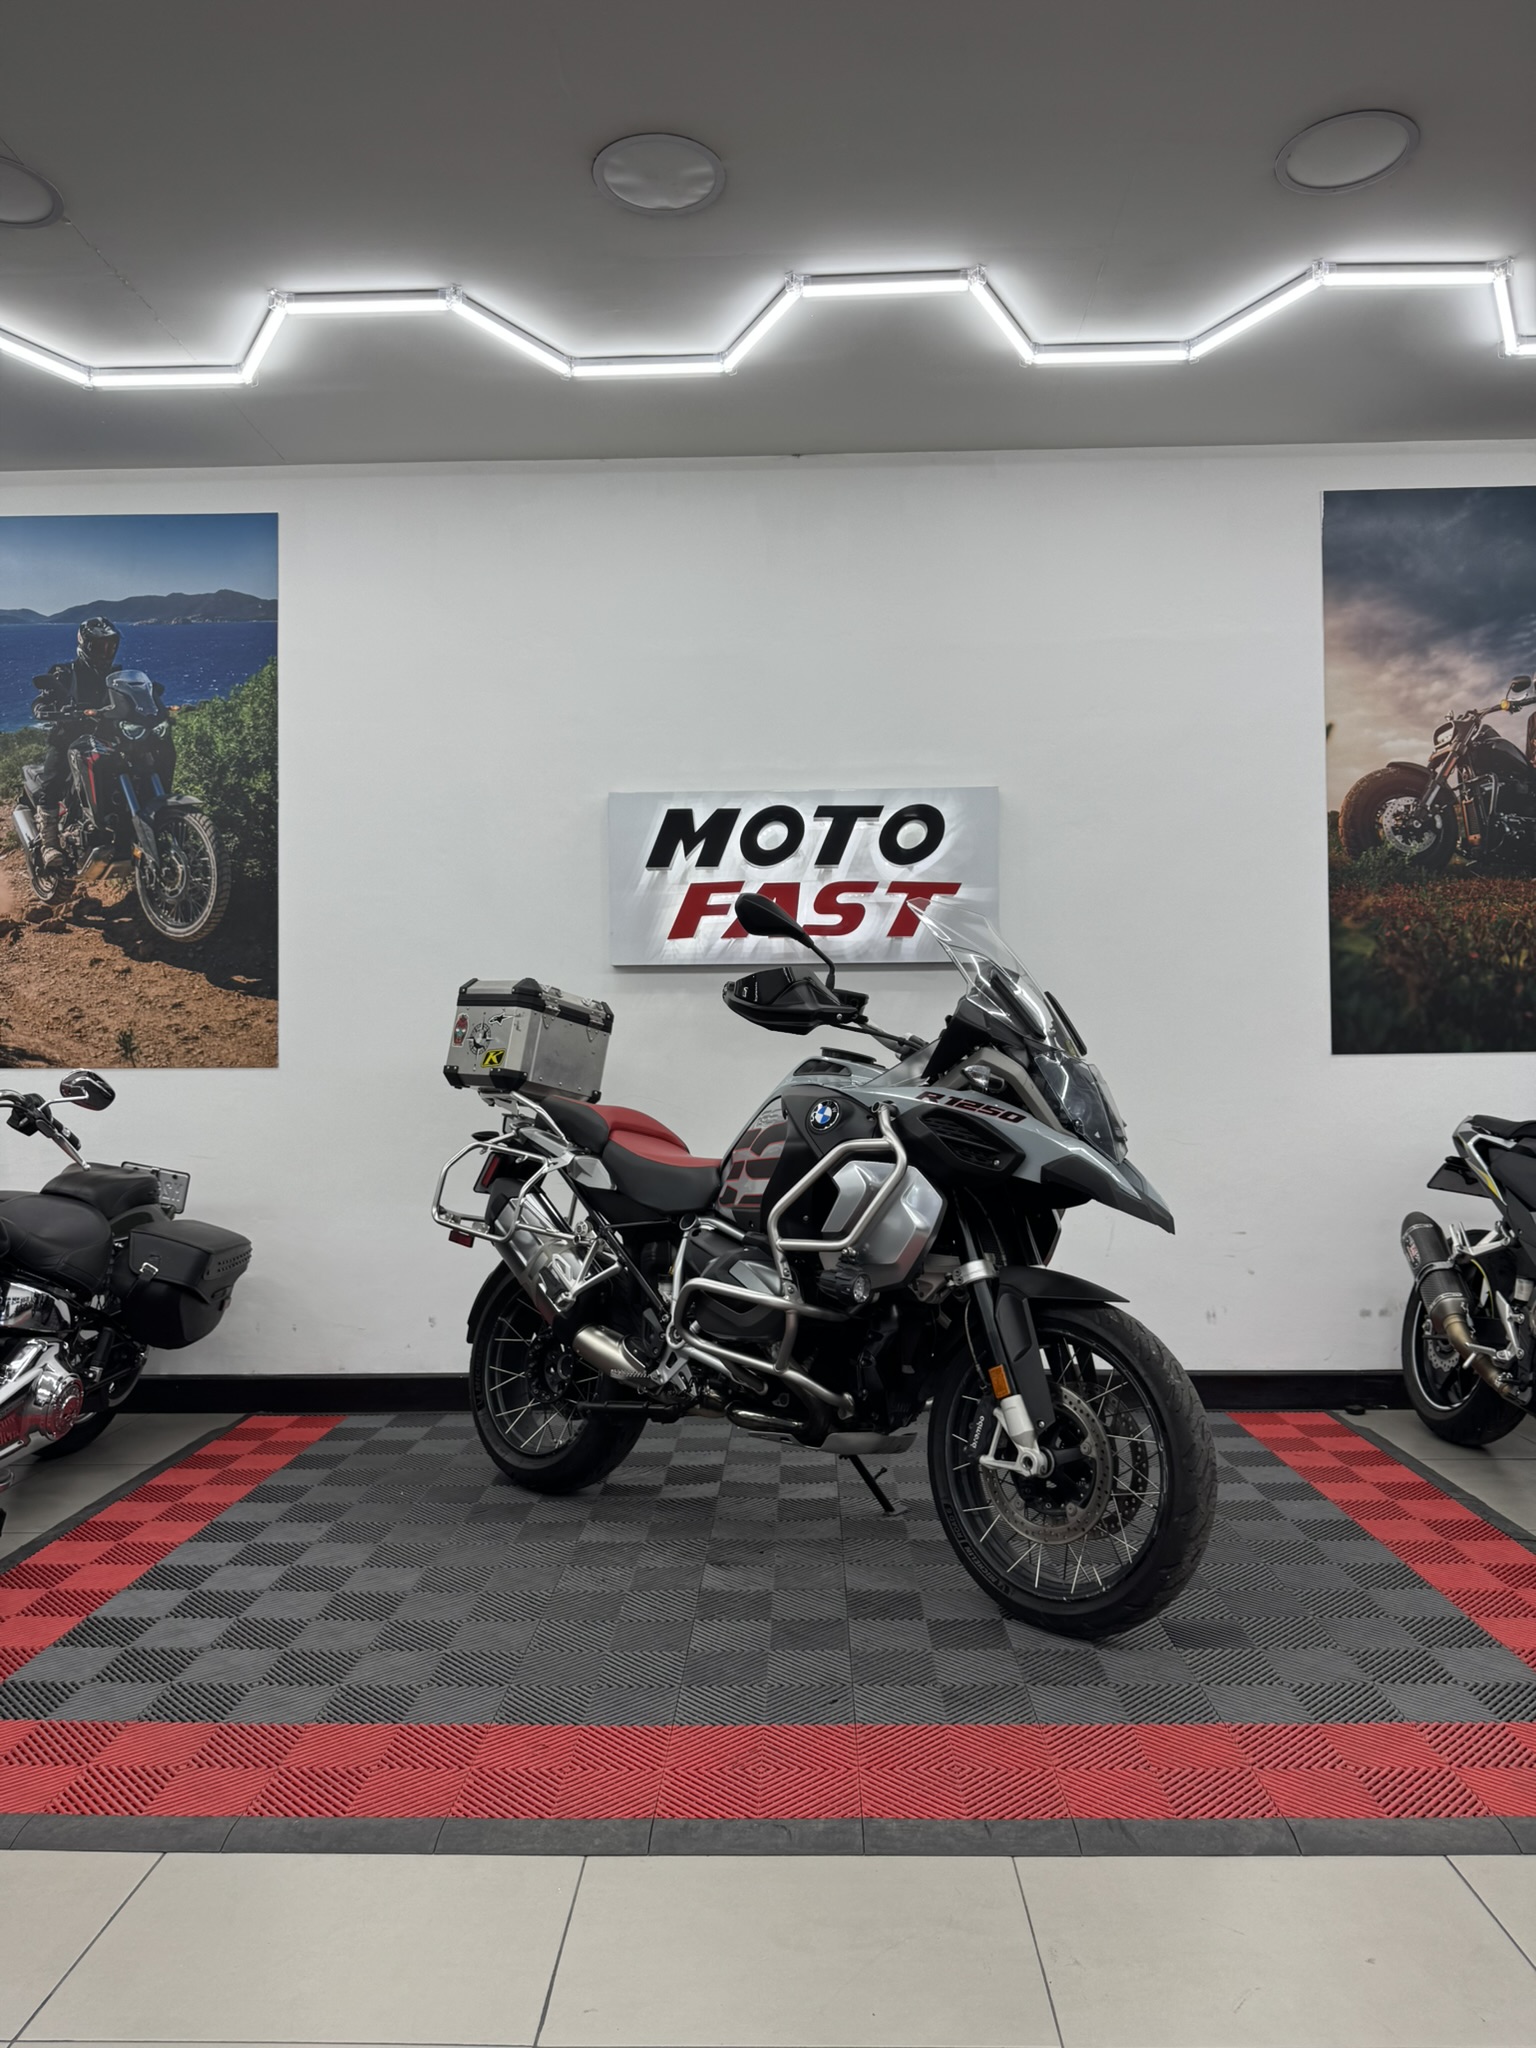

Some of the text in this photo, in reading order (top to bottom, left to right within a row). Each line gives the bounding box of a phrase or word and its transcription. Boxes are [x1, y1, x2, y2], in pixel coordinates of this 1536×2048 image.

[645, 803, 946, 871] MOTO
[667, 881, 962, 940] FAST
[915, 1091, 1027, 1124] R 1250
[971, 1415, 985, 1449] brembo
[964, 1546, 998, 1583] MICHELIN
